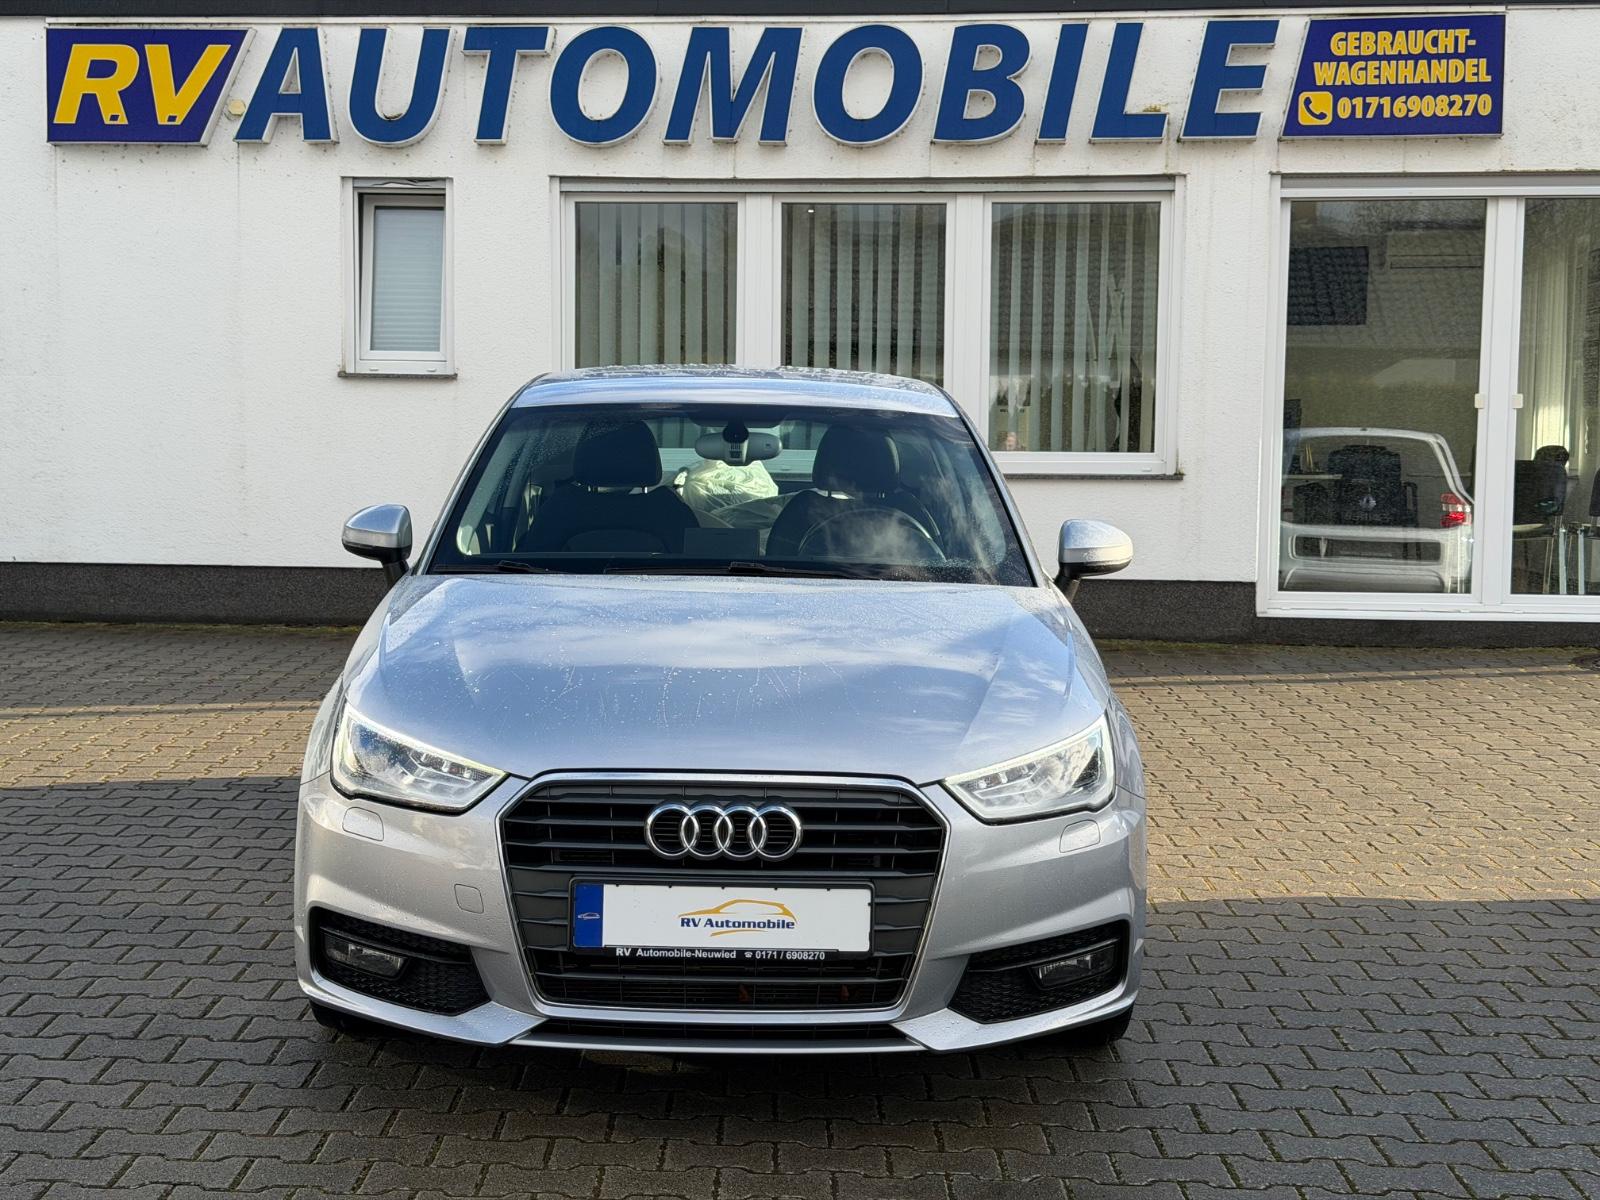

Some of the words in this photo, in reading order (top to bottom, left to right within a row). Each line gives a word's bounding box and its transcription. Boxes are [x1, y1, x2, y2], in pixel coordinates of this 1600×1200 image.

[1330, 29, 1477, 56] GEBRAUCHT-
[53, 43, 231, 126] RV
[234, 21, 1278, 147] AUTOMOBILE
[1313, 58, 1492, 86] WAGENHANDEL
[1337, 94, 1492, 119] 01716908270
[680, 917, 702, 928] RV
[703, 917, 795, 929] Automobile
[615, 947, 631, 957] RV
[636, 948, 737, 959] Automobile-Neuwied
[755, 951, 778, 960] 0171
[786, 951, 826, 961] 6908270
